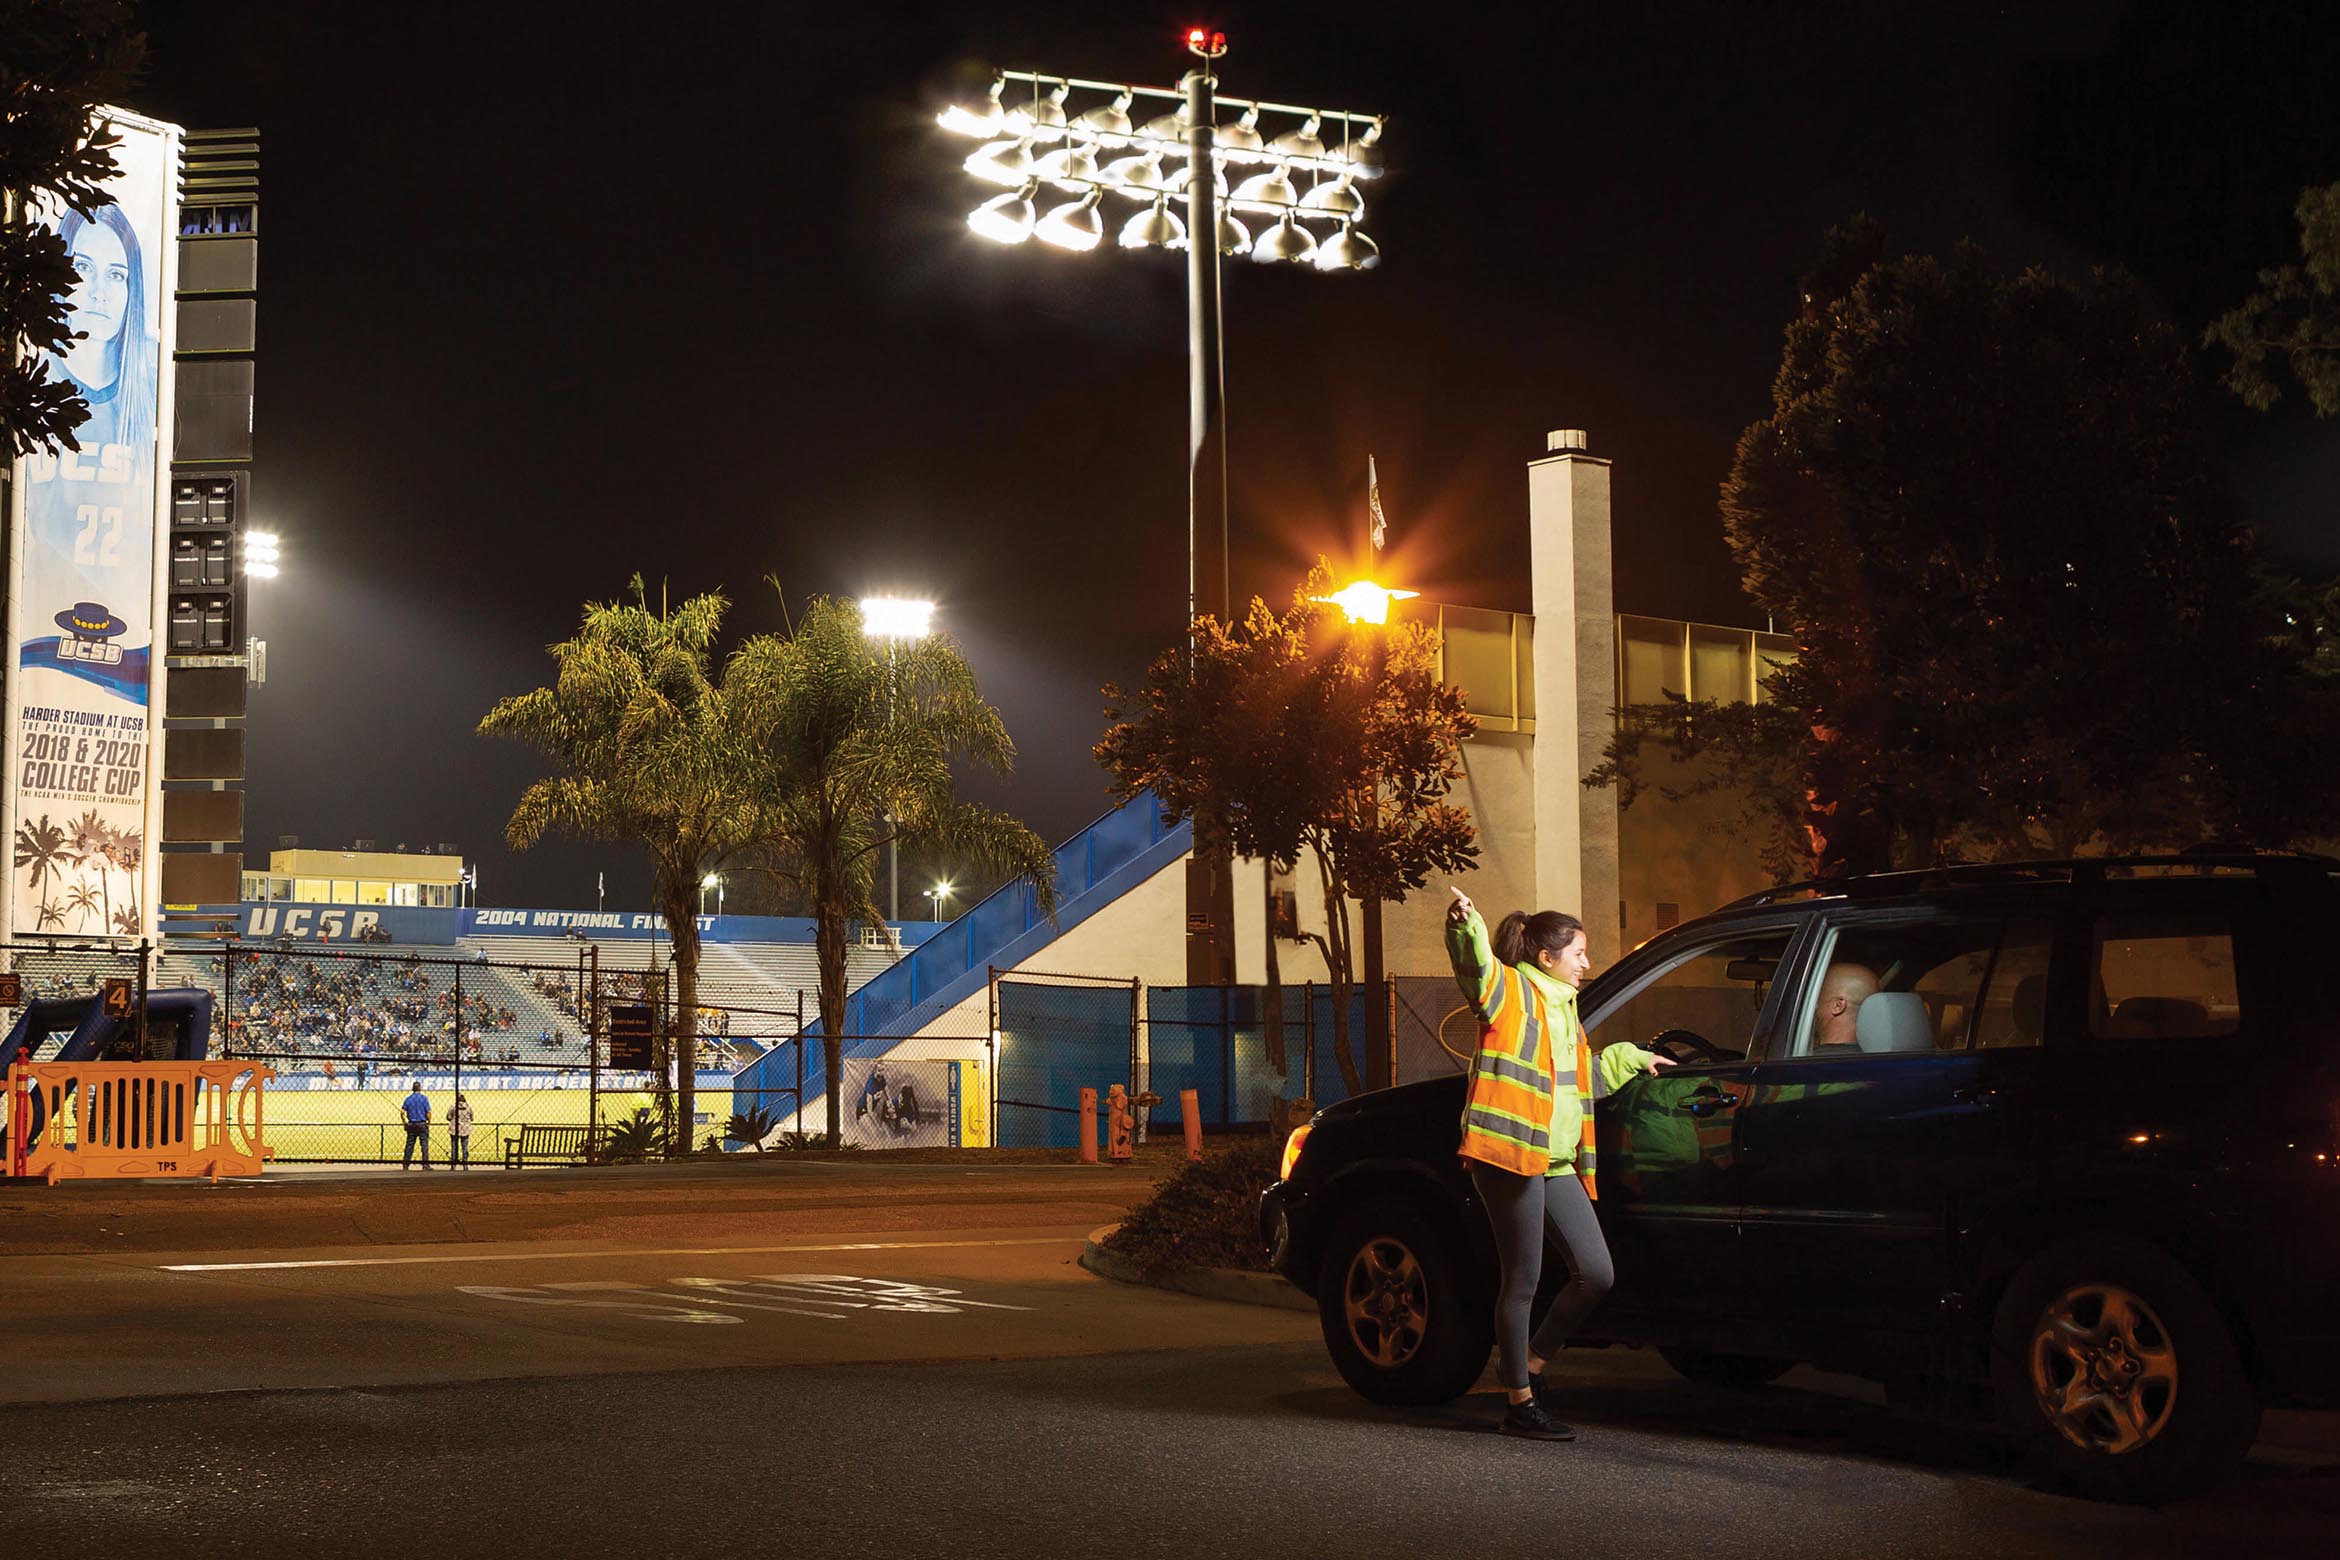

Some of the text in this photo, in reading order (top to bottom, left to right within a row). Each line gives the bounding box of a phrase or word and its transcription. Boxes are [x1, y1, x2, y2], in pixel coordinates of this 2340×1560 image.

[28, 440, 143, 484] UCS
[74, 504, 122, 566] 22
[58, 637, 123, 664] UCSB
[22, 706, 144, 731] HARDER STADIUM AT UCSB
[22, 721, 143, 741] THE PROUD HOME TO THE
[22, 733, 141, 768] 2018 & 2020
[22, 761, 141, 796] COLLEGE CUP
[247, 908, 379, 938] UCSB
[475, 910, 527, 926] 2004
[533, 911, 624, 929] NATIONAL
[109, 987, 127, 1009] 4
[157, 1161, 177, 1172] TPS
[454, 1273, 1041, 1325] STOP
